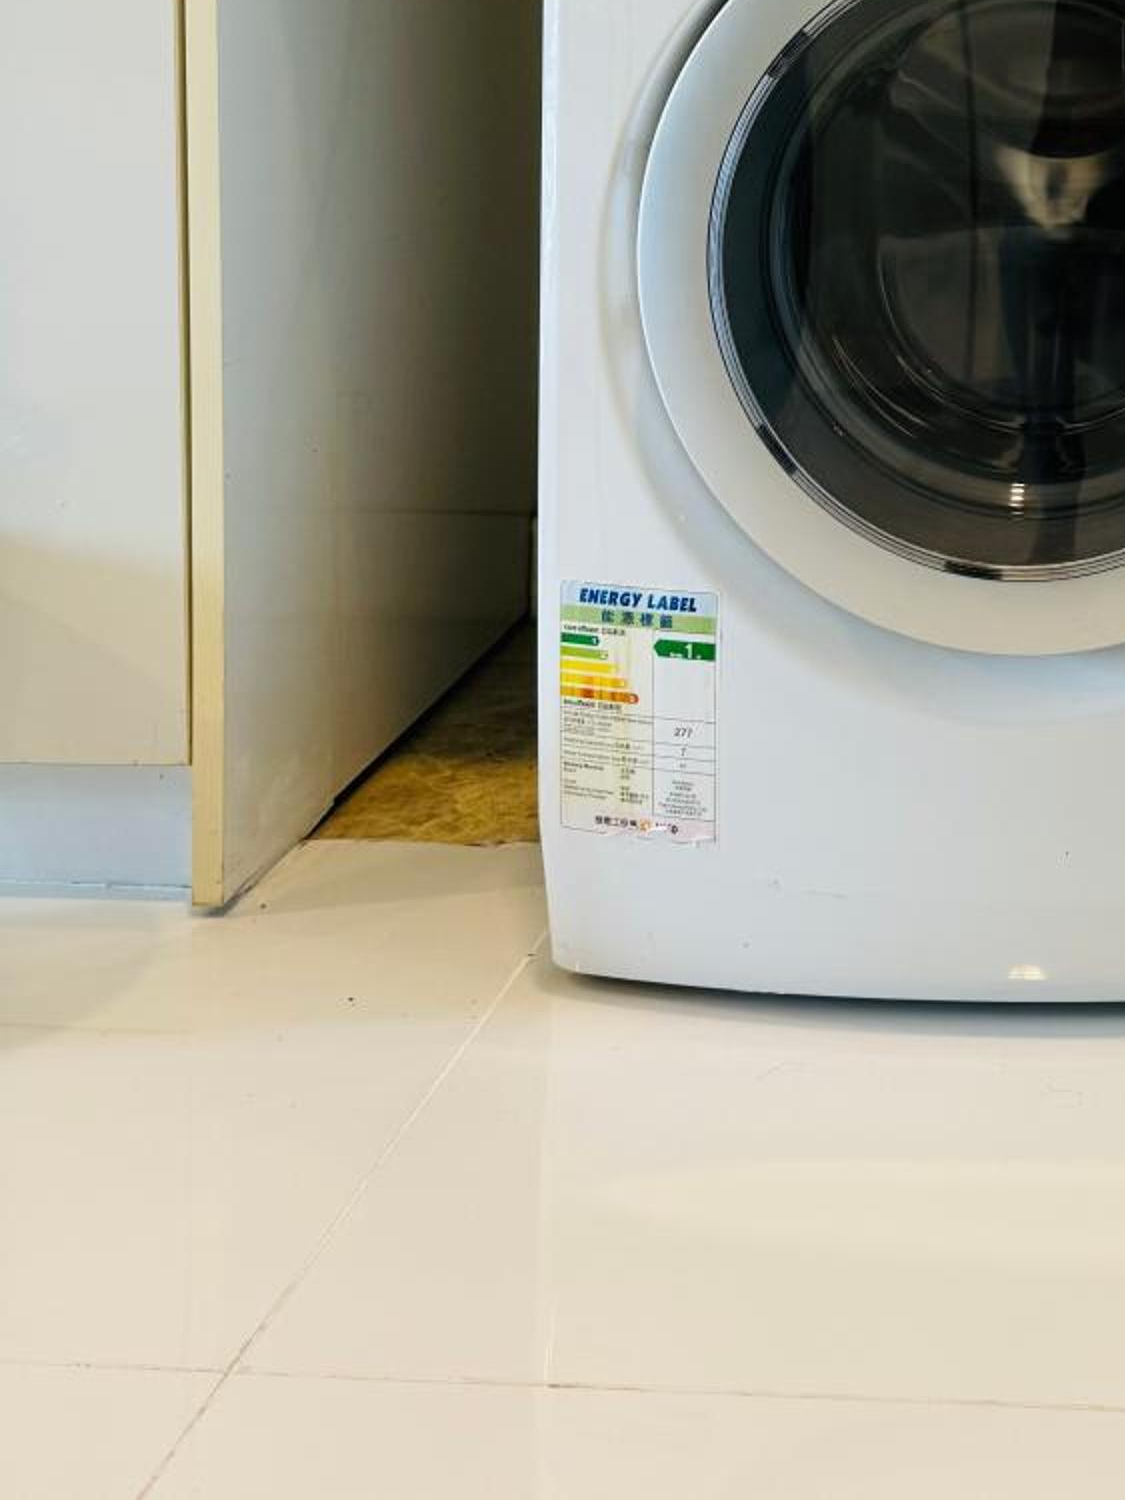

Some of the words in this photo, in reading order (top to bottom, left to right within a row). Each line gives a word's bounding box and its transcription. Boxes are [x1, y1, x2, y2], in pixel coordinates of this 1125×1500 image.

[579, 587, 643, 608] ENERGY
[647, 593, 698, 613] LABEL
[685, 643, 694, 659] 1
